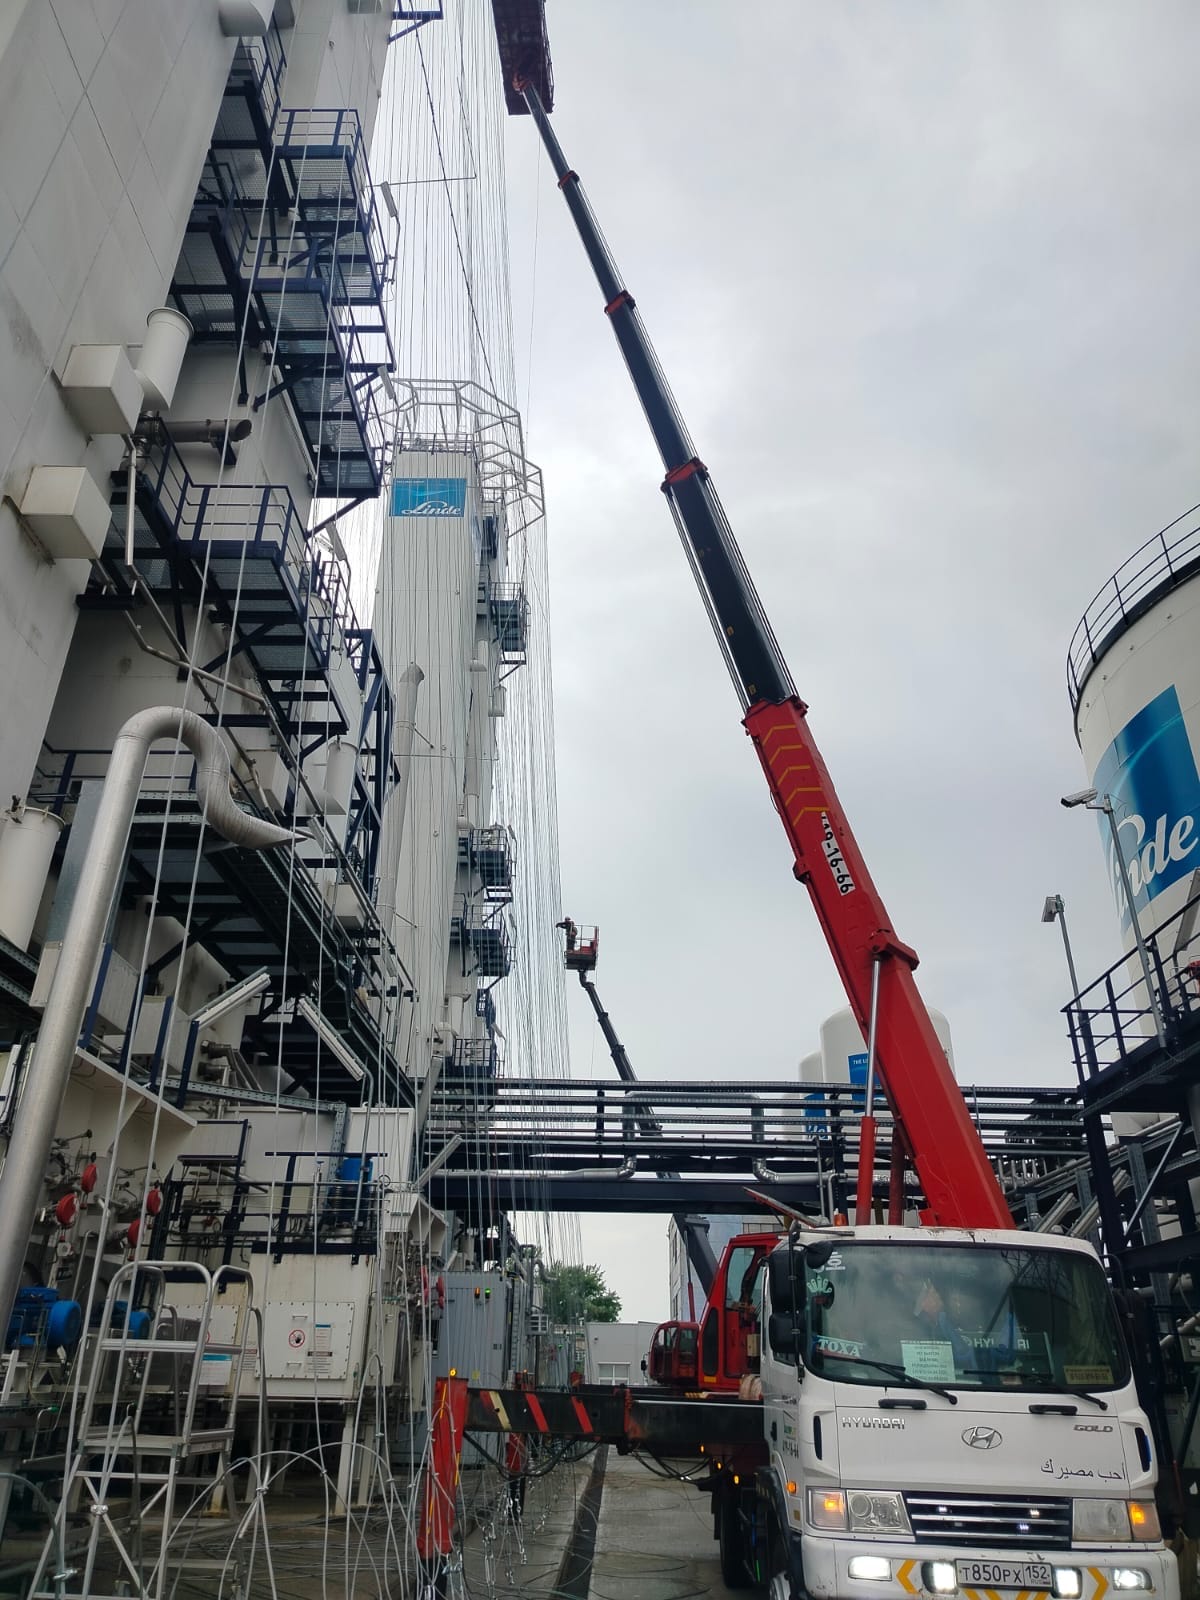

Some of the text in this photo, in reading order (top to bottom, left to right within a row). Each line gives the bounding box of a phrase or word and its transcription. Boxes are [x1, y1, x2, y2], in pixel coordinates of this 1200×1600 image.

[401, 500, 461, 515] Linde
[842, 1416, 905, 1430] HYUNDAI
[1074, 1424, 1114, 1433] GOLD
[962, 1563, 1048, 1583] Т850РХ 152
